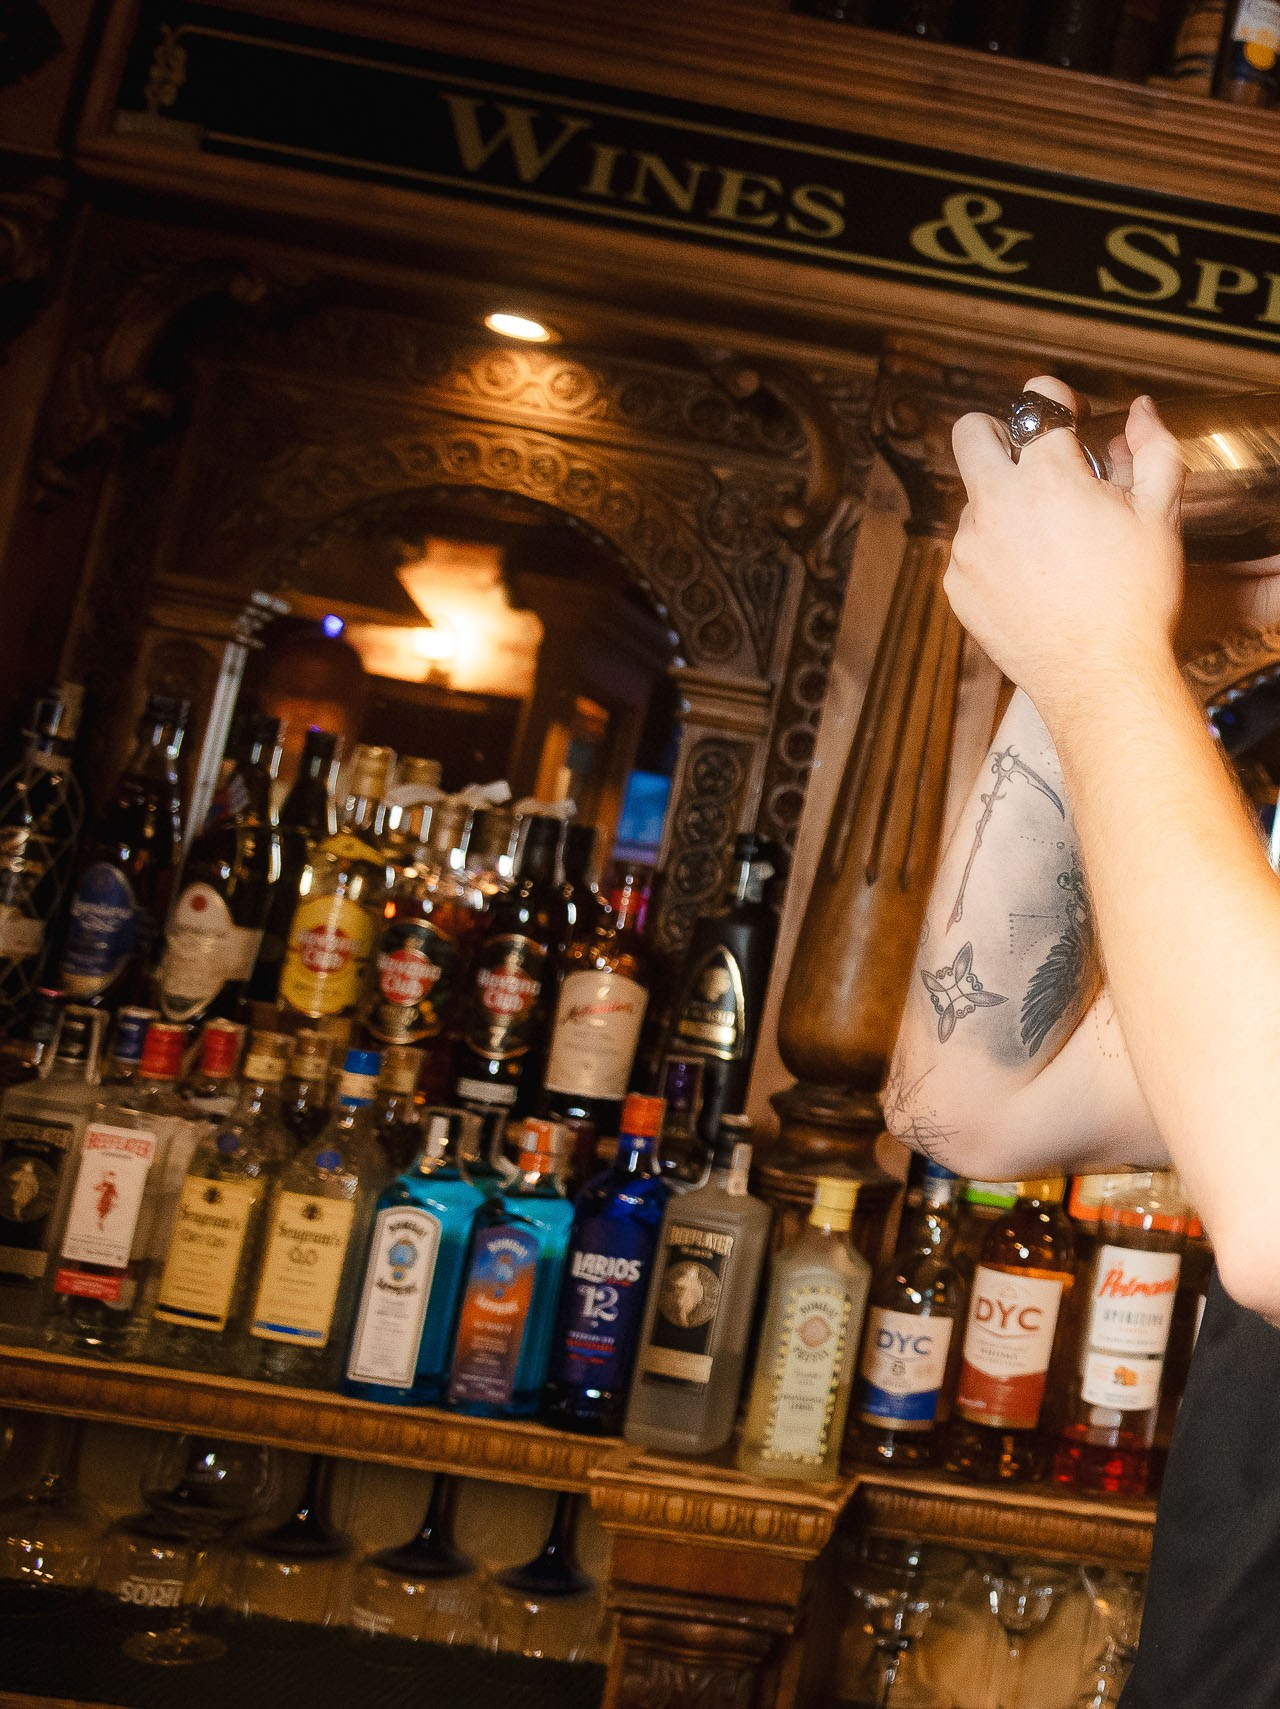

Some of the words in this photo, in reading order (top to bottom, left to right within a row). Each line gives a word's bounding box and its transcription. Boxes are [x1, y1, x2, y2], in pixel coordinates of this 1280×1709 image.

[440, 92, 848, 241] WINES
[909, 193, 1034, 274] &
[571, 1251, 642, 1283] LARIOS
[576, 1284, 620, 1323] 12
[973, 1297, 1044, 1332] DYC
[874, 1327, 935, 1356] DYC
